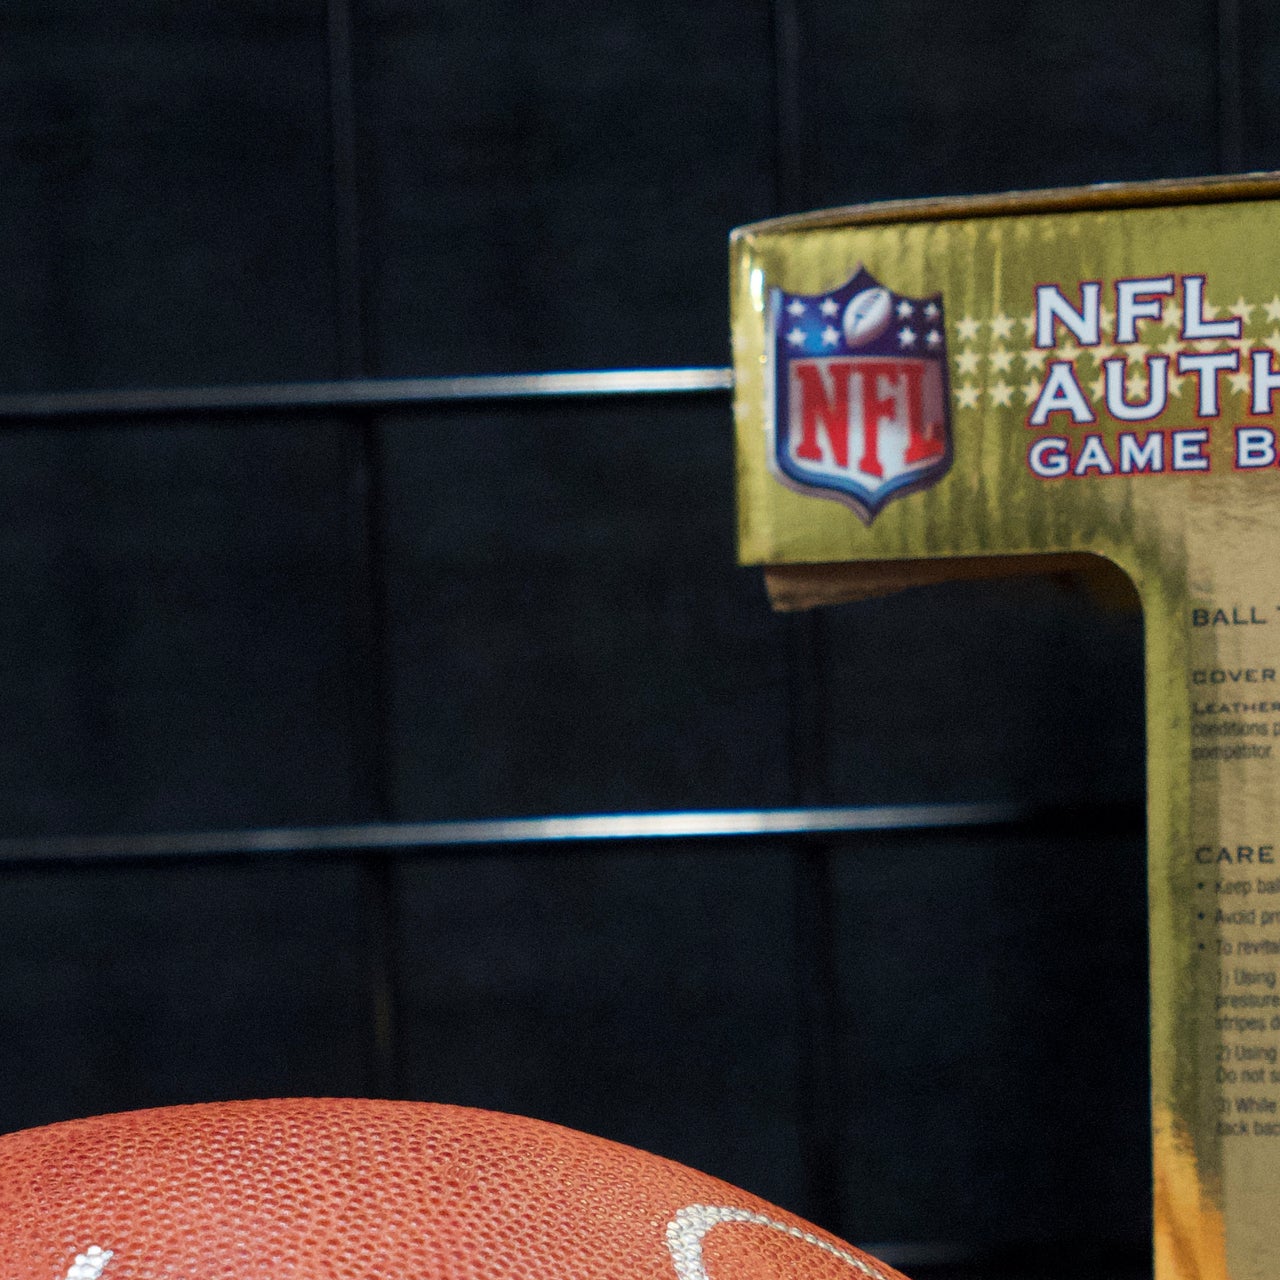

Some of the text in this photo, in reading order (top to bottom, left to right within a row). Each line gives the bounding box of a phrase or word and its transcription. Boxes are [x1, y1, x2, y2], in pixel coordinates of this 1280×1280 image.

[1033, 274, 1243, 349] NFL
[795, 361, 946, 478] NFL
[1028, 427, 1212, 479] GAME
[1192, 606, 1267, 627] BALL
[1192, 669, 1277, 685] COVER
[1195, 847, 1275, 864] CARE
